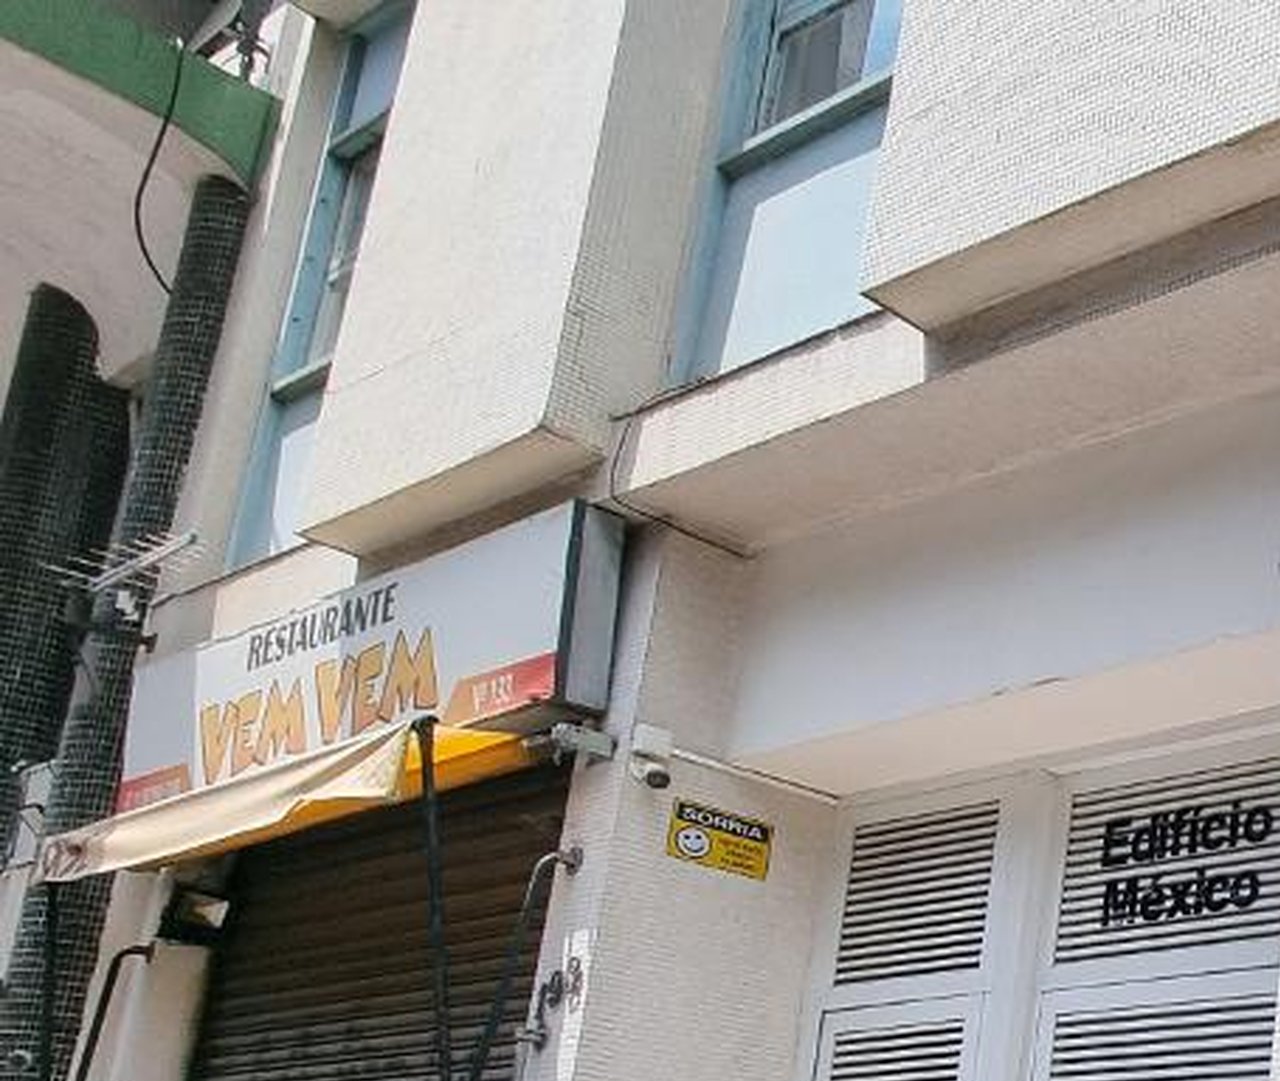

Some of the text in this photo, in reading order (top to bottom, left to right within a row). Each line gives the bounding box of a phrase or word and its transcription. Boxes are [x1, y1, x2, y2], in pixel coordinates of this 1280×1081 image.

[247, 582, 399, 672] RESTAURANTE
[201, 627, 438, 785] VEM VEM
[682, 808, 762, 839] SORRIA
[1101, 800, 1274, 867] Edifício
[1101, 867, 1260, 926] México
